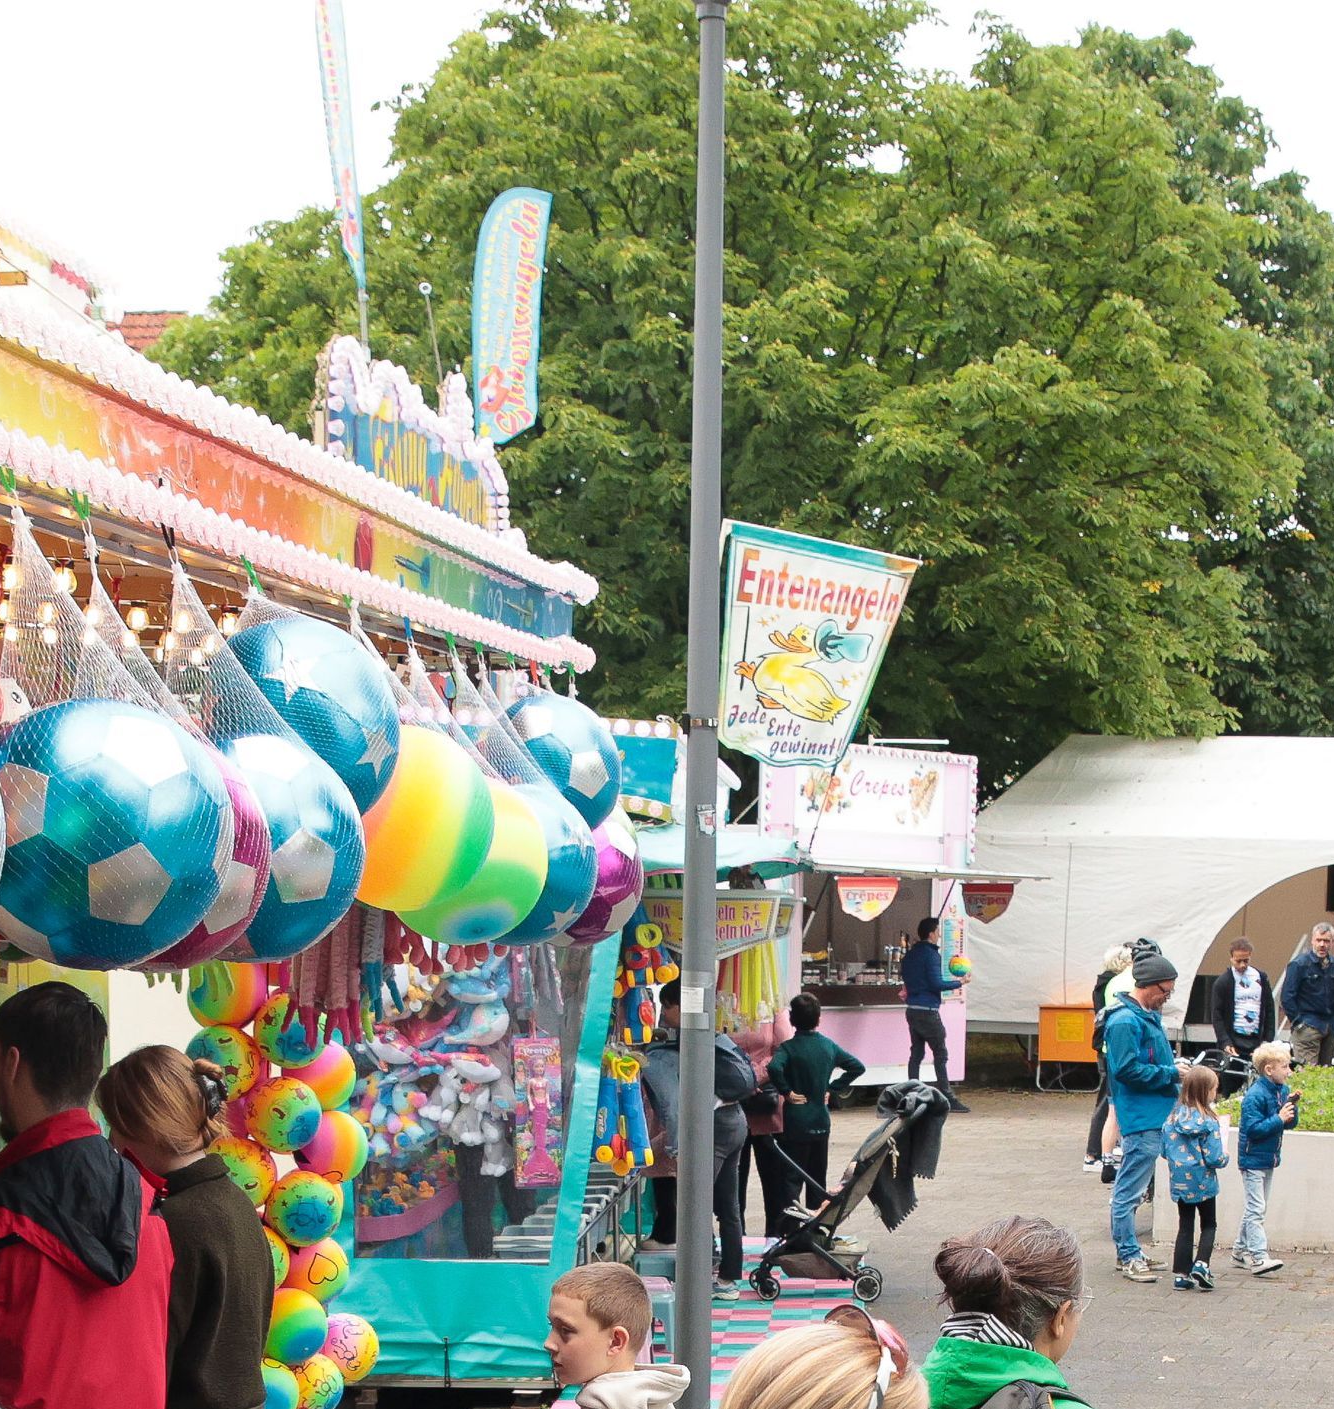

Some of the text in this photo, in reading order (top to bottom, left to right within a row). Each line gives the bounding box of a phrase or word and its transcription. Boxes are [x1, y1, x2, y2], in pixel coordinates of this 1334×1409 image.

[736, 548, 900, 631] Entenangeln
[727, 704, 767, 728] Jede
[767, 717, 801, 737] Ente
[769, 737, 843, 758] gewinnt!
